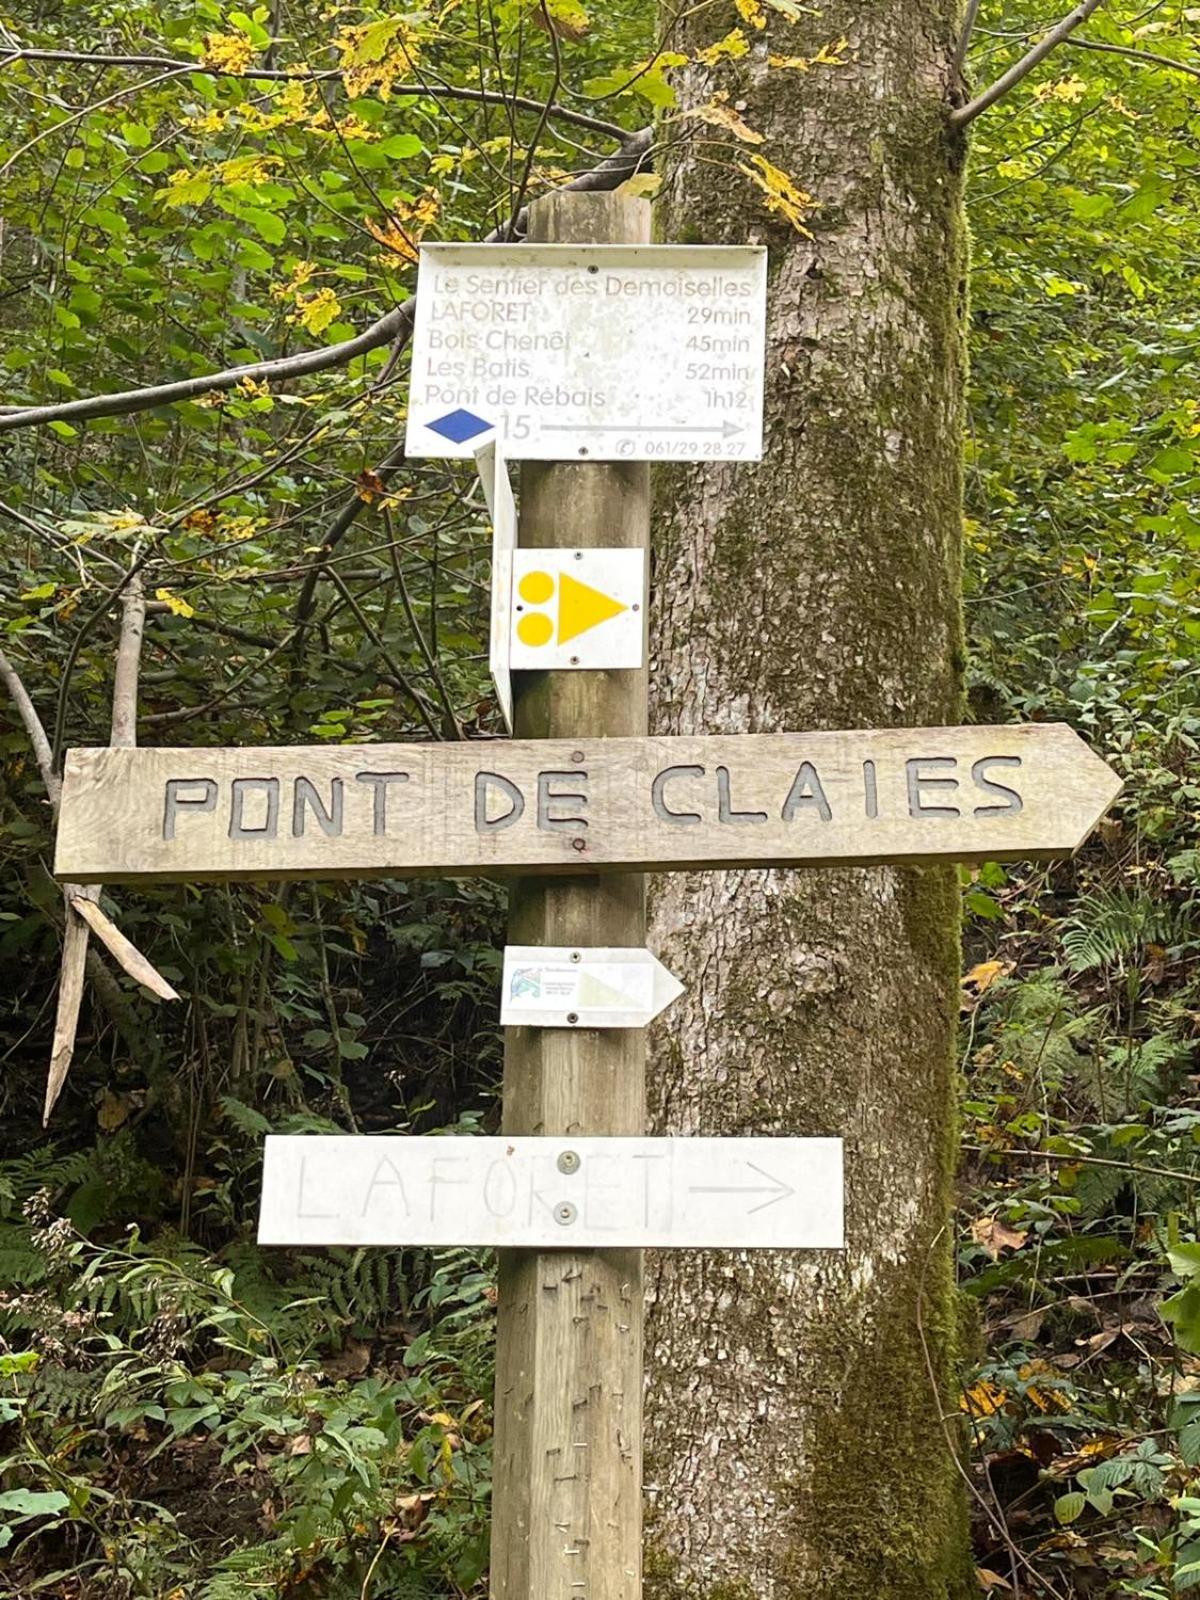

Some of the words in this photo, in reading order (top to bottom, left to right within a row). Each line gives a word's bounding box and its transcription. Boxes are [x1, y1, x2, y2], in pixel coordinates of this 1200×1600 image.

[434, 275, 459, 295] Le
[466, 275, 548, 296] Sentier
[554, 275, 598, 297] des
[605, 276, 751, 298] Demoiselles
[431, 302, 531, 322] LAFORET
[687, 307, 751, 325] 29min
[686, 335, 751, 354] 45min
[427, 358, 467, 378] Les
[685, 363, 750, 382] 52min
[425, 386, 480, 406] Pont
[485, 386, 517, 406] de
[704, 391, 748, 409] 1h12
[500, 413, 531, 441] 15
[645, 441, 698, 456] 061/29
[703, 442, 722, 456] 28
[727, 442, 746, 456] 27
[162, 771, 409, 841] PONT
[474, 771, 588, 829] DE
[651, 756, 1023, 825] CLAIES
